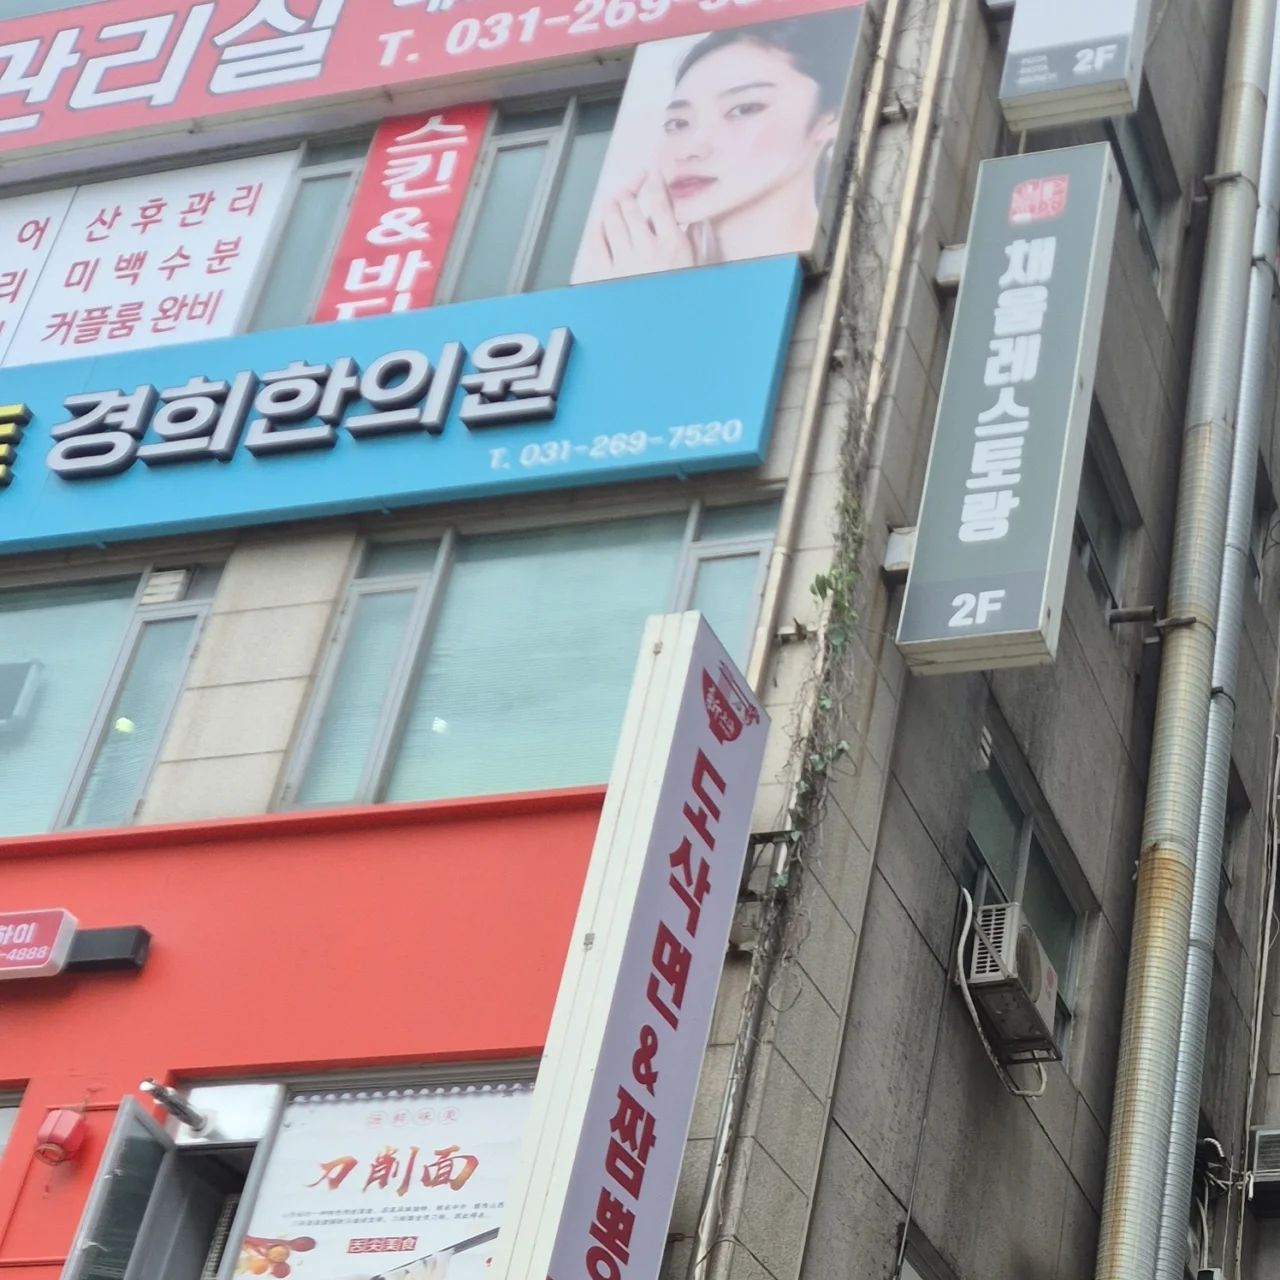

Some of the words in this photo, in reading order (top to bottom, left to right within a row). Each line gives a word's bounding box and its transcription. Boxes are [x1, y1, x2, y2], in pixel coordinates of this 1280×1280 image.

[378, 28, 420, 67] T.
[1072, 44, 1117, 75] 2F
[17, 217, 50, 251] 어
[41, 301, 144, 345] 커플룸
[150, 289, 224, 333] 완비
[46, 327, 572, 479] 경희한의원
[948, 588, 1006, 628] 2F
[305, 1145, 479, 1197] 刀削面
